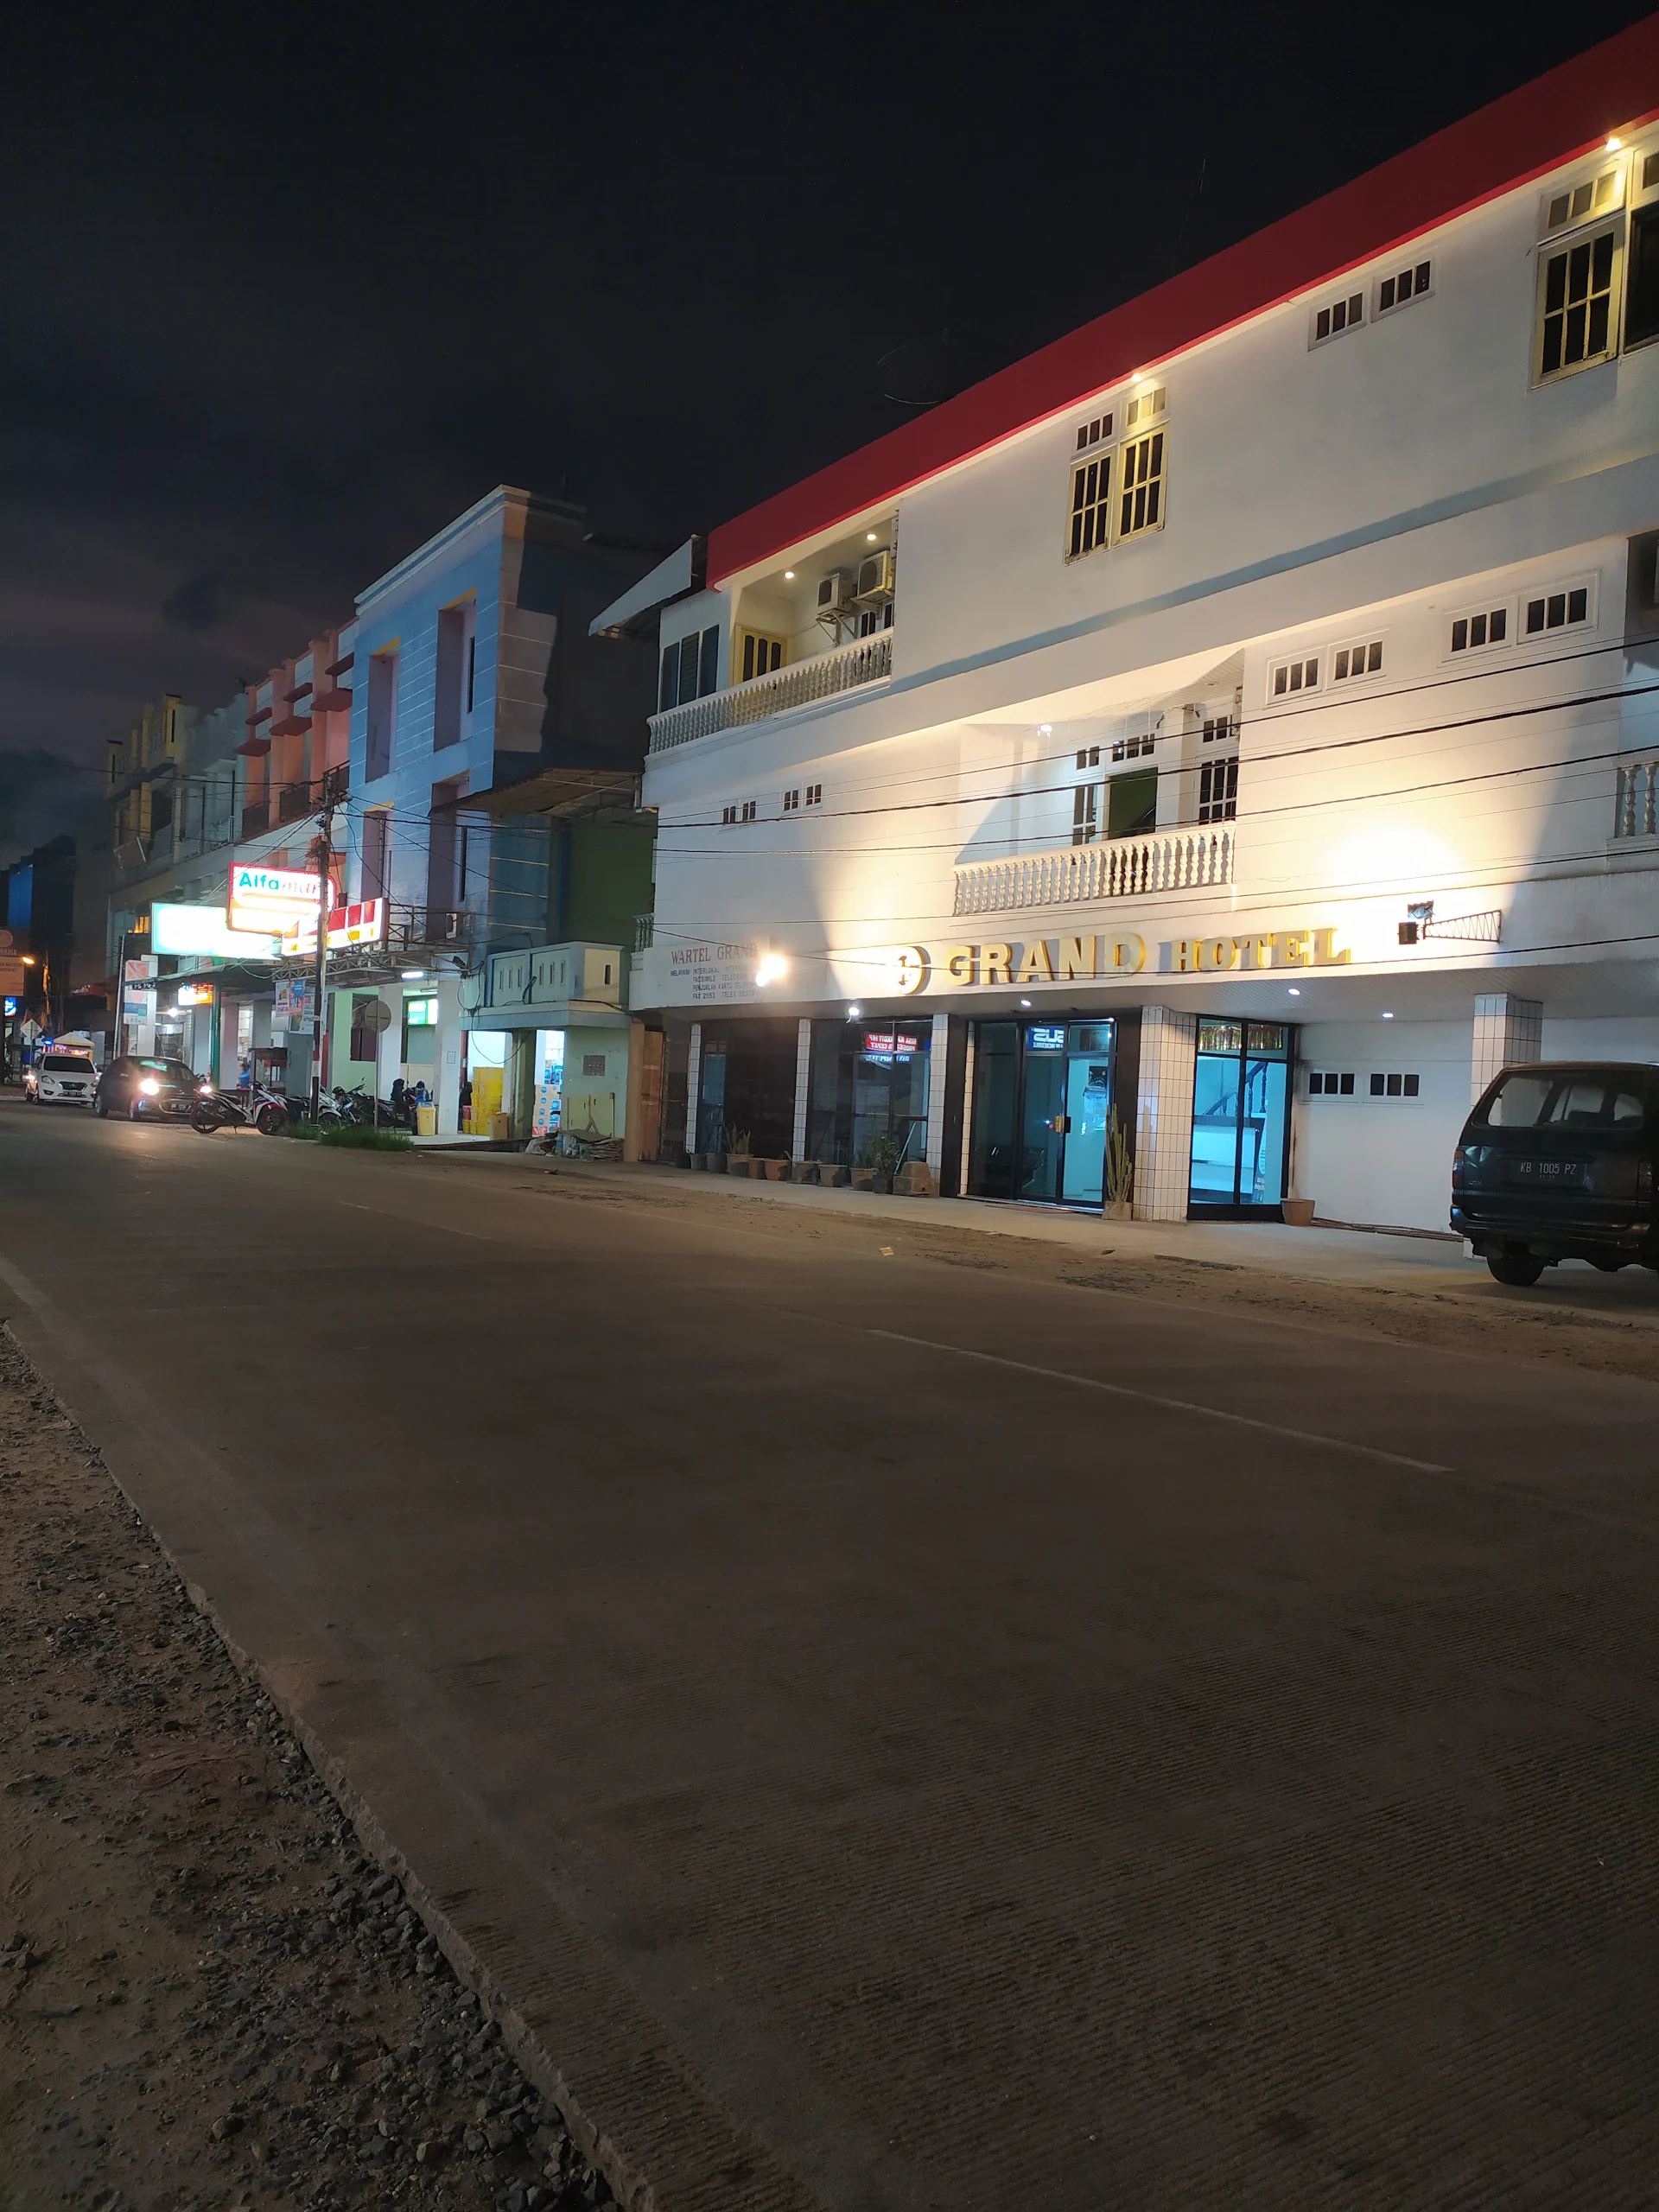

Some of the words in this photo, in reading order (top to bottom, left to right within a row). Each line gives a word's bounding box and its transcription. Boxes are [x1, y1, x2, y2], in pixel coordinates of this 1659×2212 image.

[238, 872, 322, 894] Alfamar
[671, 948, 711, 965] WARTEL
[717, 943, 757, 960] GRAND
[944, 932, 1146, 986] GRAND
[1171, 927, 1351, 972] HOTEL
[1521, 1162, 1532, 1173] KB
[1539, 1162, 1560, 1174] 1005
[1565, 1163, 1577, 1175] PZ
